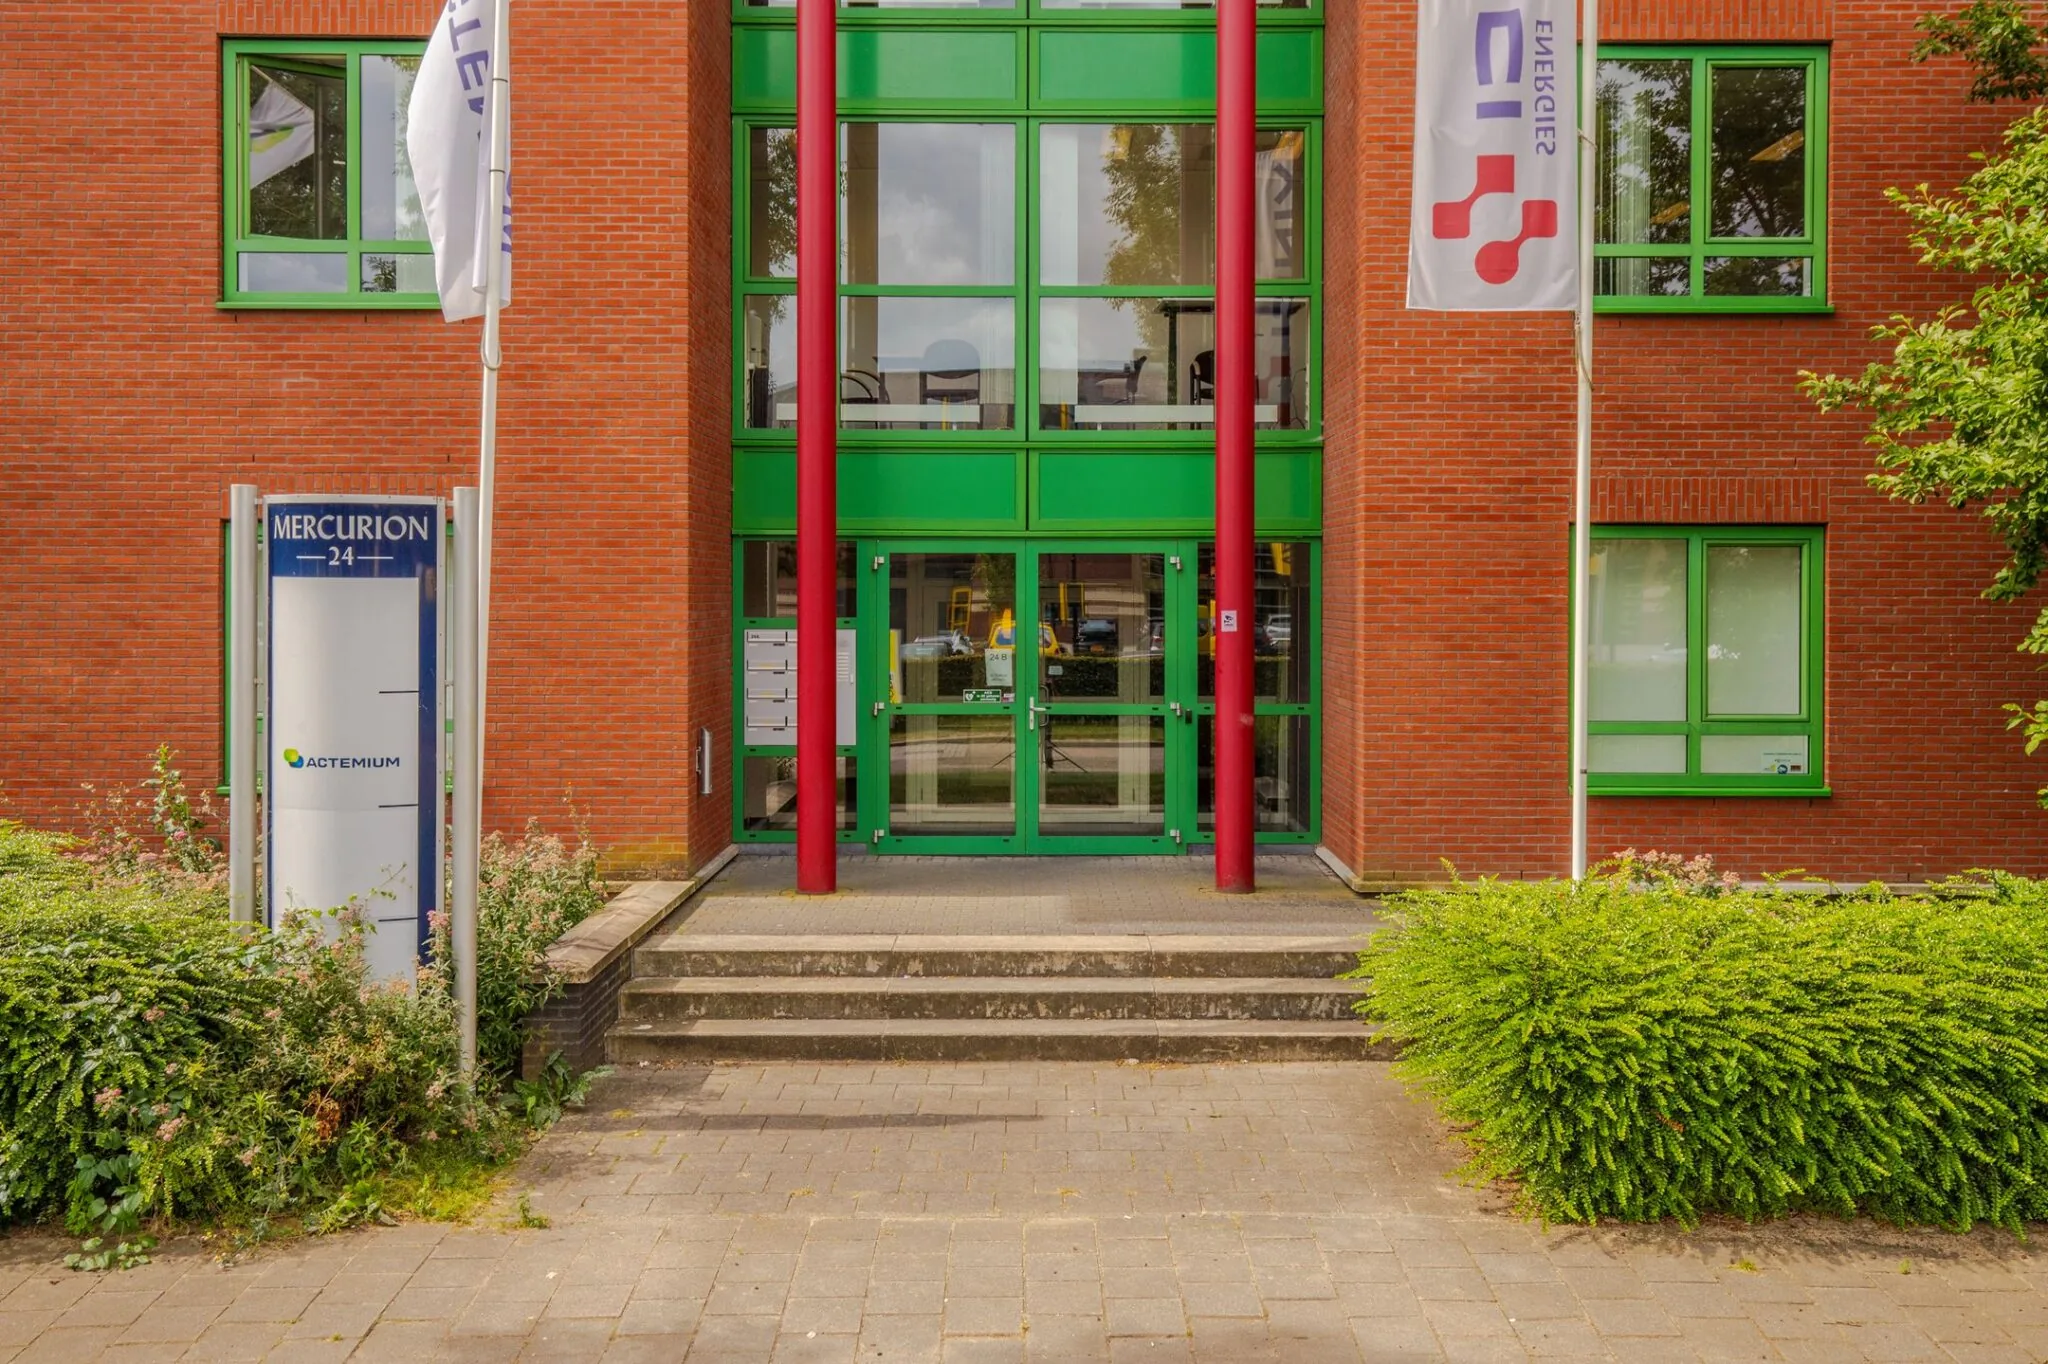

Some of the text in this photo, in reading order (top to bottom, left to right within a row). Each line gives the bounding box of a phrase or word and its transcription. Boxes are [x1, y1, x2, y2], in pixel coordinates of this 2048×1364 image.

[273, 515, 428, 540] MERCURION
[328, 547, 354, 566] 24
[989, 653, 1008, 661] 24 B
[306, 756, 400, 769] ACTEMIUM
